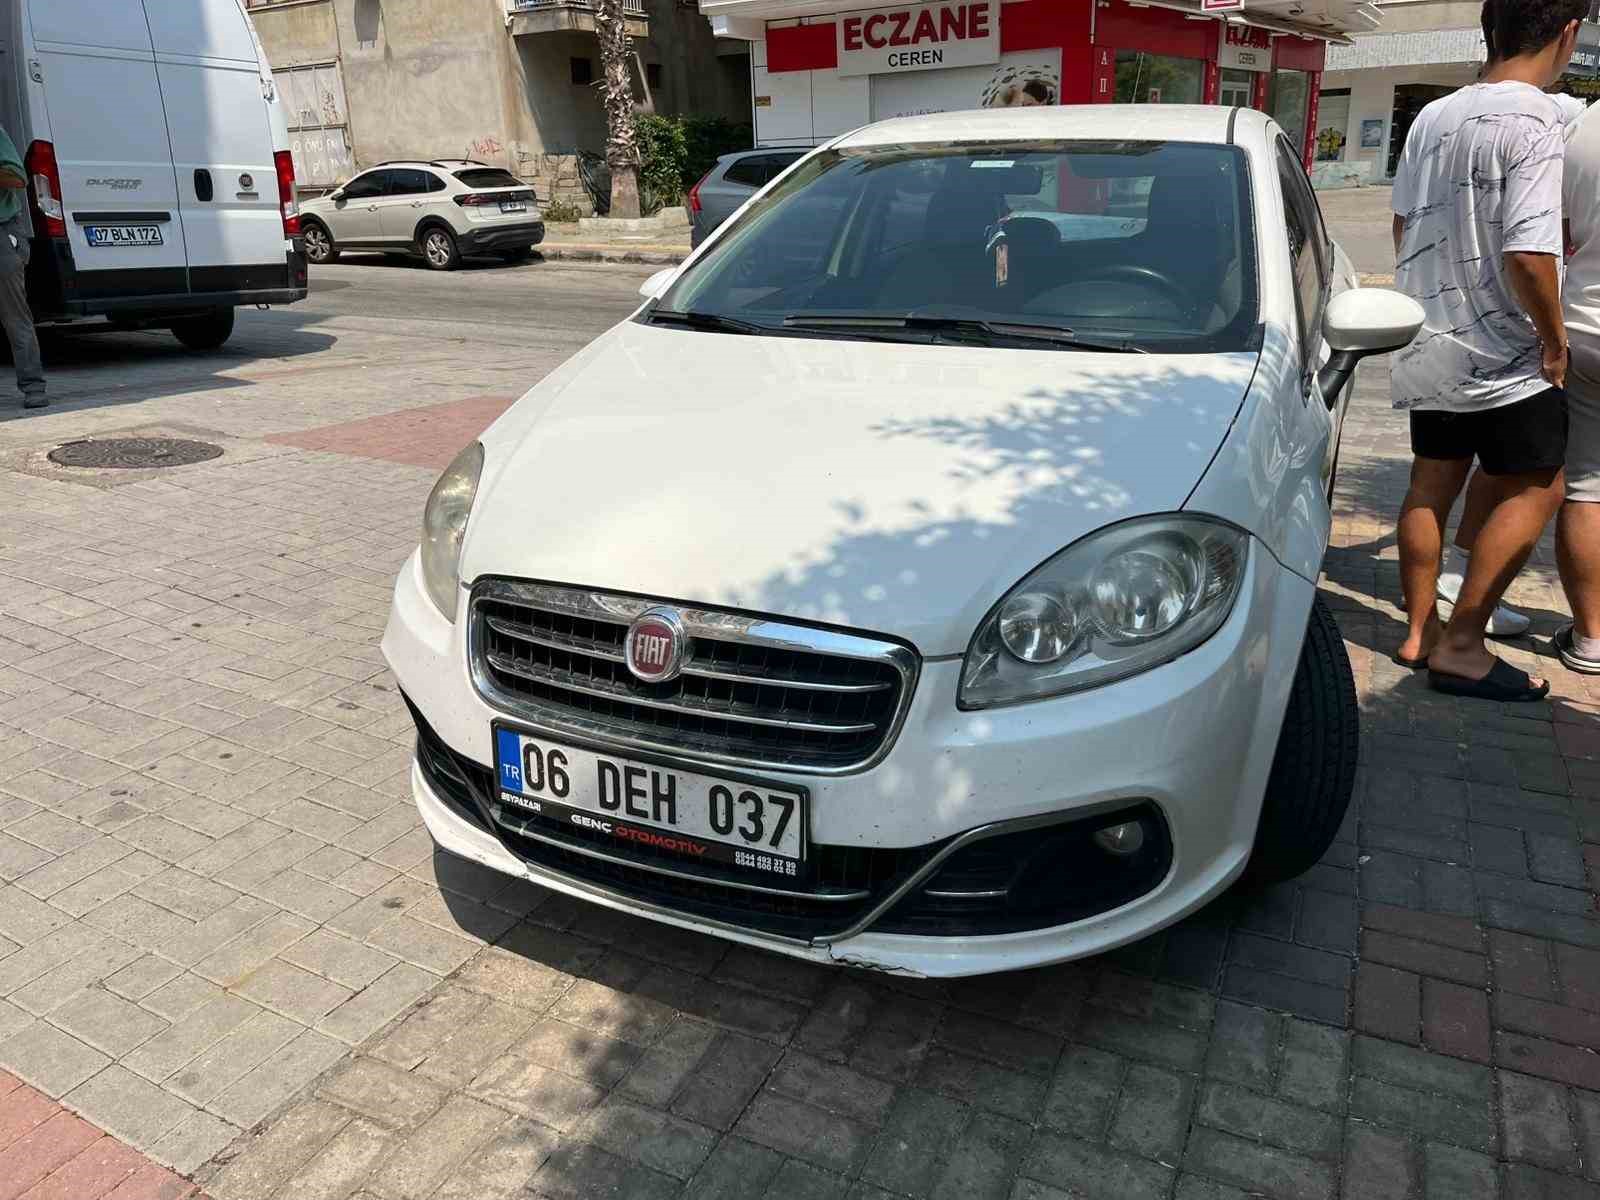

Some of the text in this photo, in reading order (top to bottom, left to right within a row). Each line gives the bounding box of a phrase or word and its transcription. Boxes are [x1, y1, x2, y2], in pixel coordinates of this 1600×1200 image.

[844, 3, 989, 50] ECZANE
[888, 50, 943, 67] CEREN
[95, 228, 159, 241] 07 BLN 172
[635, 633, 670, 665] FIAT
[503, 763, 520, 781] TR
[501, 792, 542, 812] BEYPAZARI
[522, 743, 794, 849] 06 DEH 037
[570, 814, 612, 834] GENÇ
